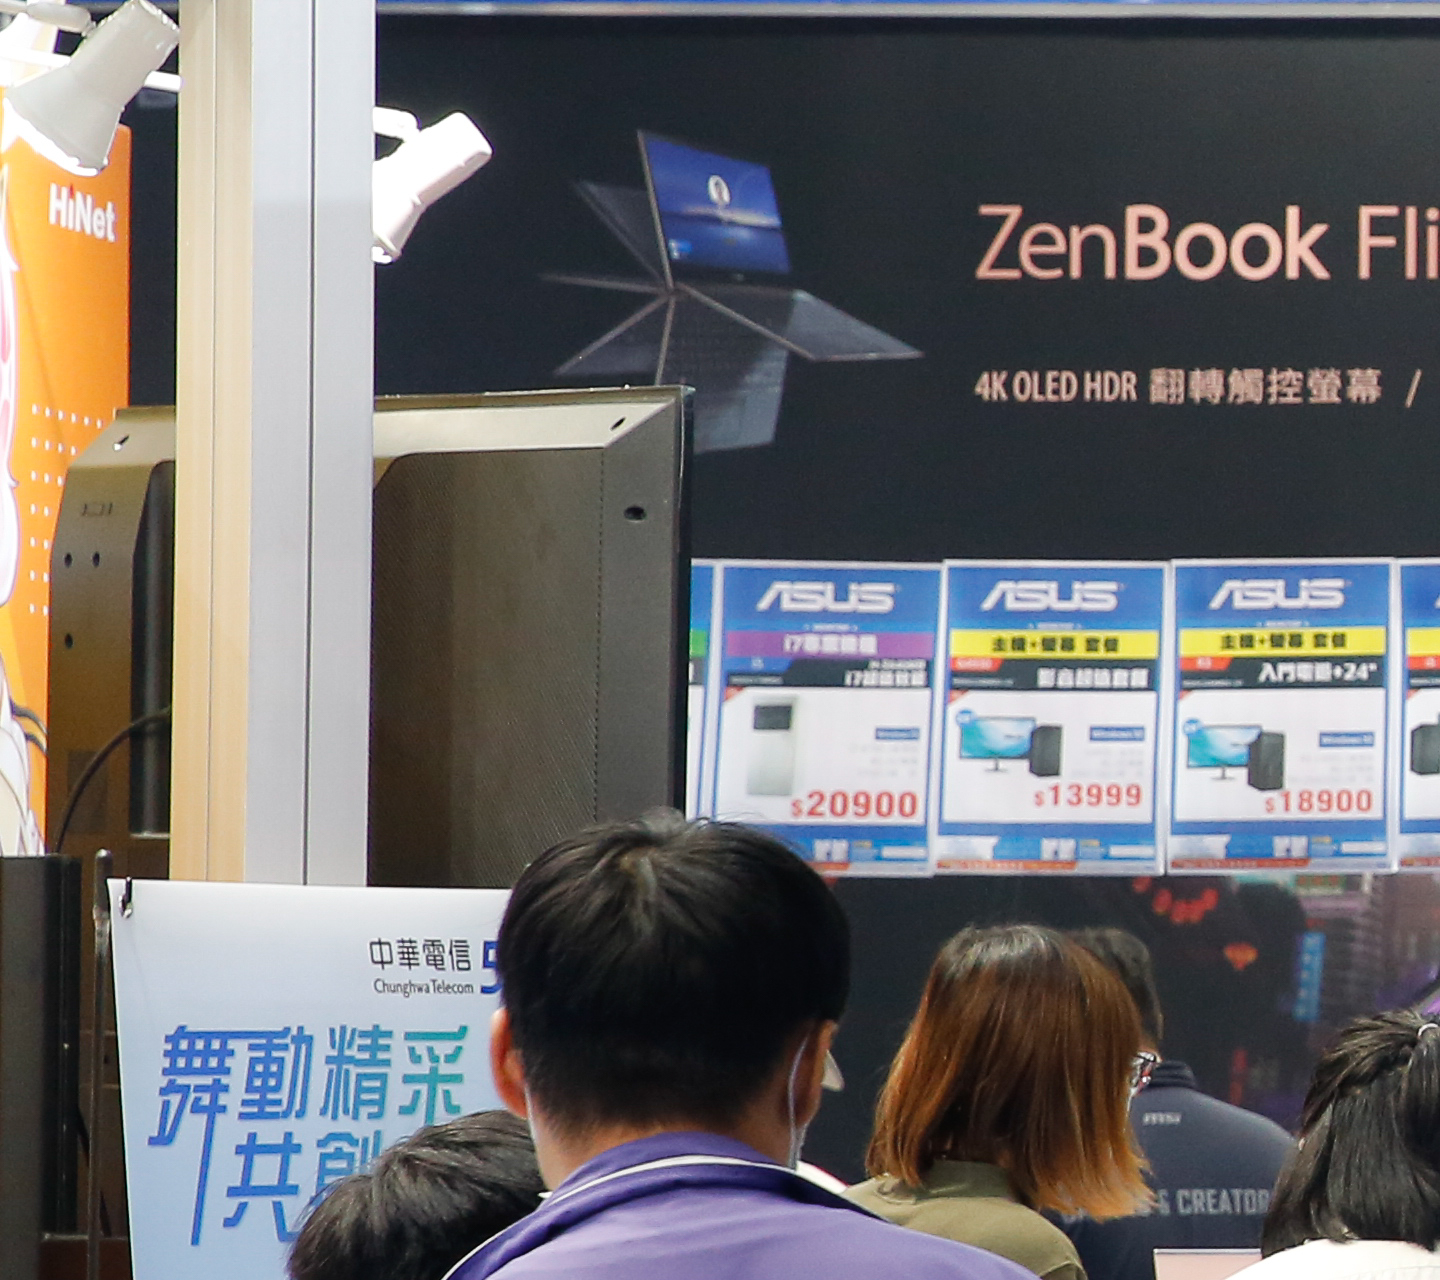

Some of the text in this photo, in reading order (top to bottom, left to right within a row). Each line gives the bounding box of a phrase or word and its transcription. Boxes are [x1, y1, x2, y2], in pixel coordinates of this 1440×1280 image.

[48, 182, 116, 243] HiNet
[975, 203, 1330, 281] ZenBook
[974, 370, 1007, 402] 4K
[1012, 370, 1079, 403] OLED
[1083, 370, 1138, 403] HDR
[1149, 367, 1382, 405] 翻轉觸控螢幕
[756, 581, 895, 611] ASUS
[980, 581, 1120, 611] ASUS
[1209, 578, 1347, 610] ASUS
[791, 791, 917, 818] $20900
[1033, 784, 1141, 809] $13999
[1264, 790, 1371, 815] $18900
[369, 937, 473, 972] 中華電信
[373, 977, 475, 999] Chunghwa Telecom
[147, 1023, 472, 1247] 舞動精采
